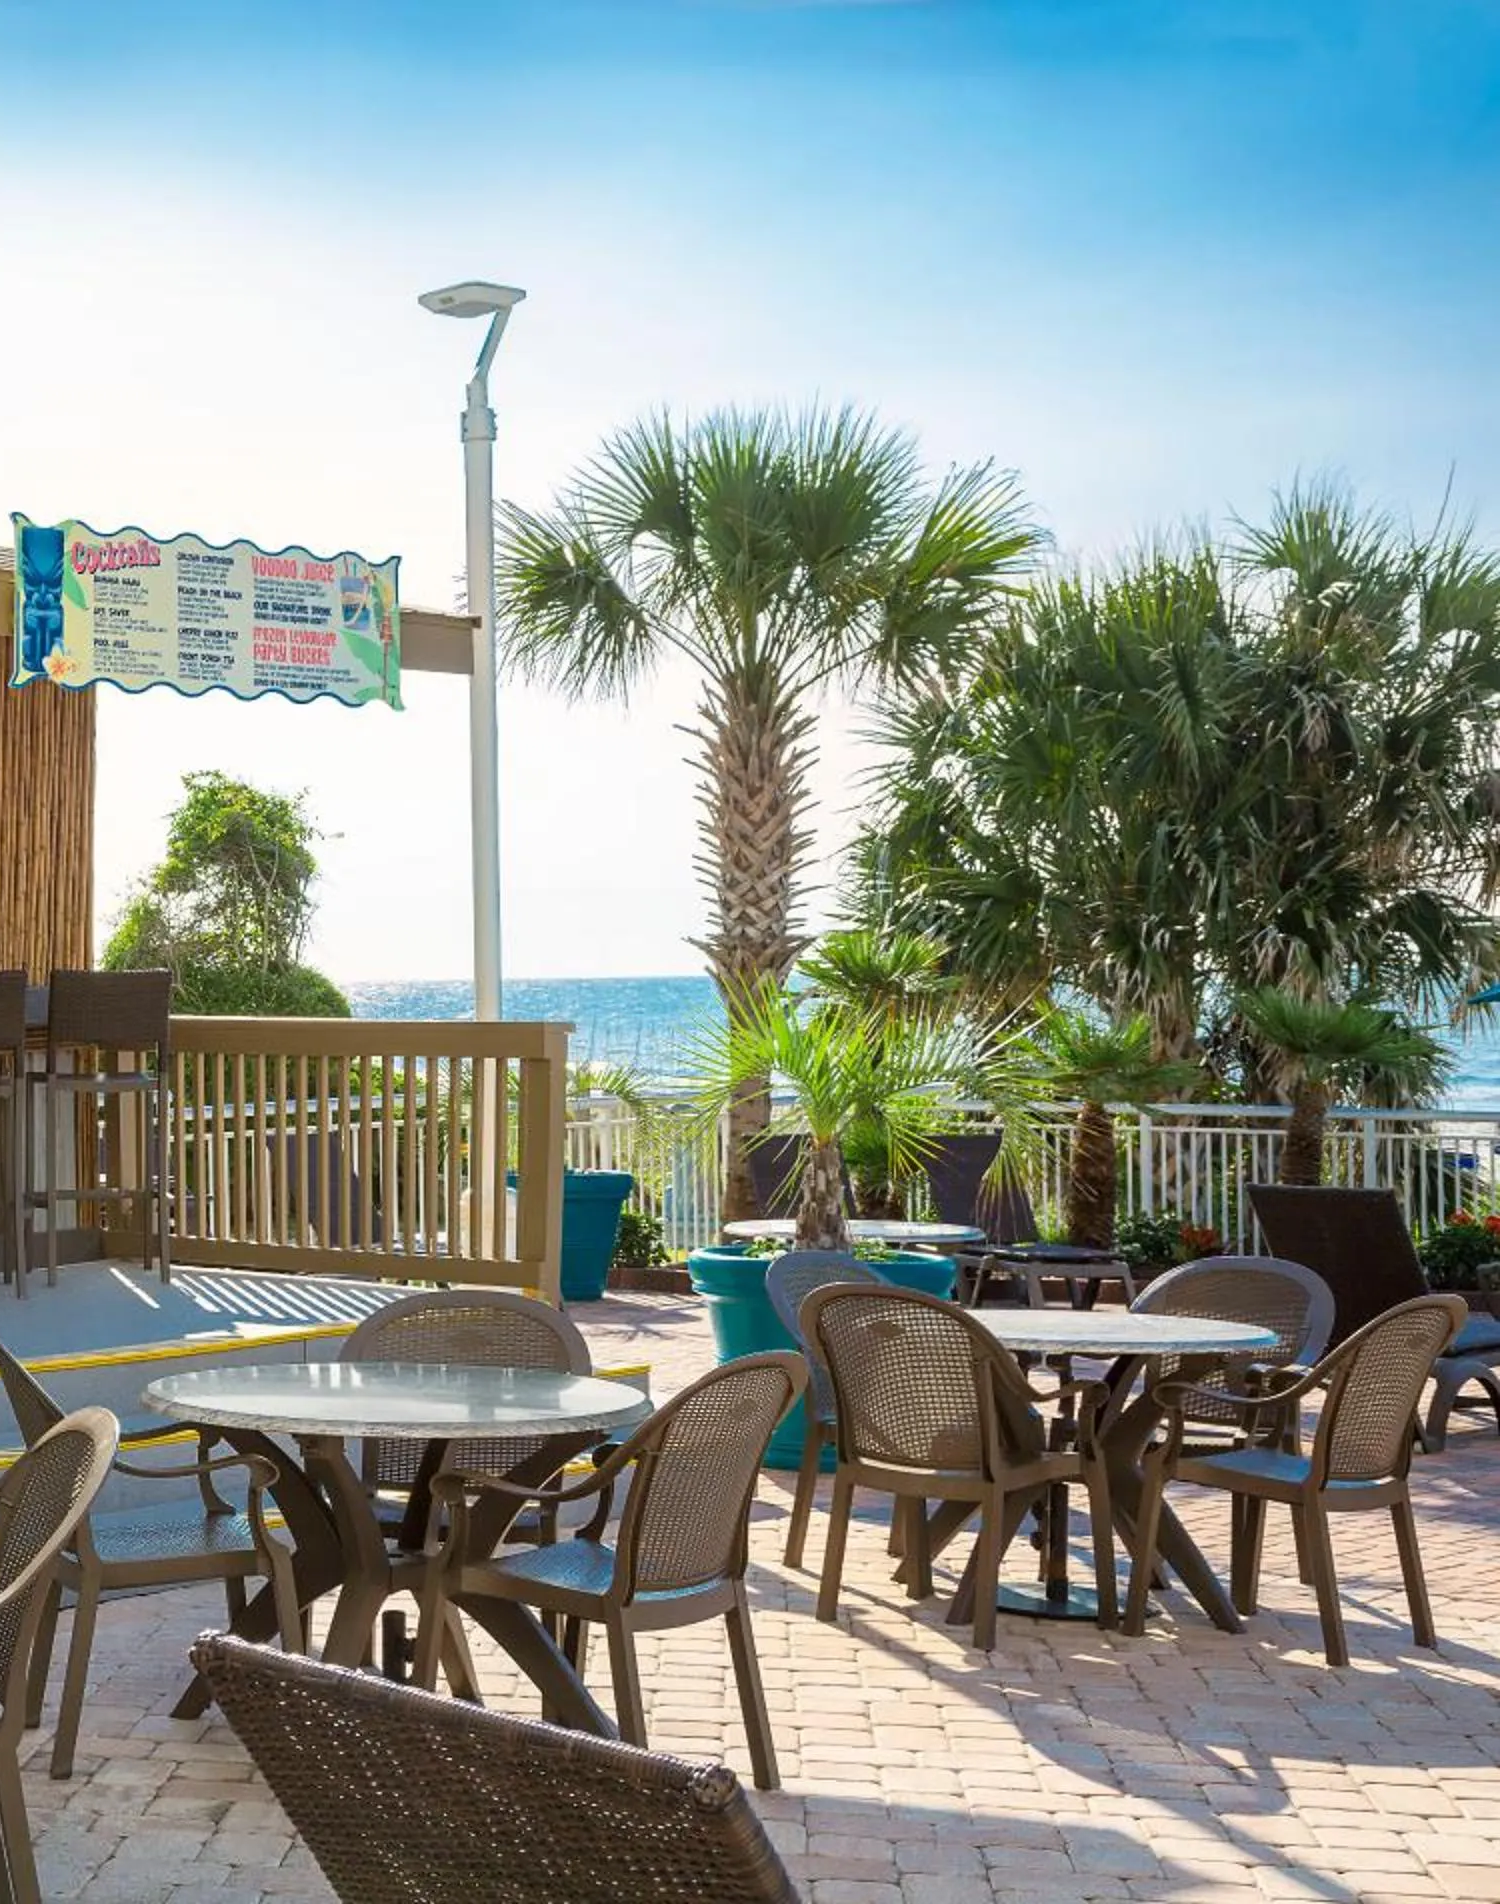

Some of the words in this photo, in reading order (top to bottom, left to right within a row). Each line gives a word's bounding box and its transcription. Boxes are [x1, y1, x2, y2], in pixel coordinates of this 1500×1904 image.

[71, 539, 161, 574] Cocktails
[209, 589, 222, 598] THE
[223, 590, 243, 601] BEACH
[253, 599, 269, 611] OUR
